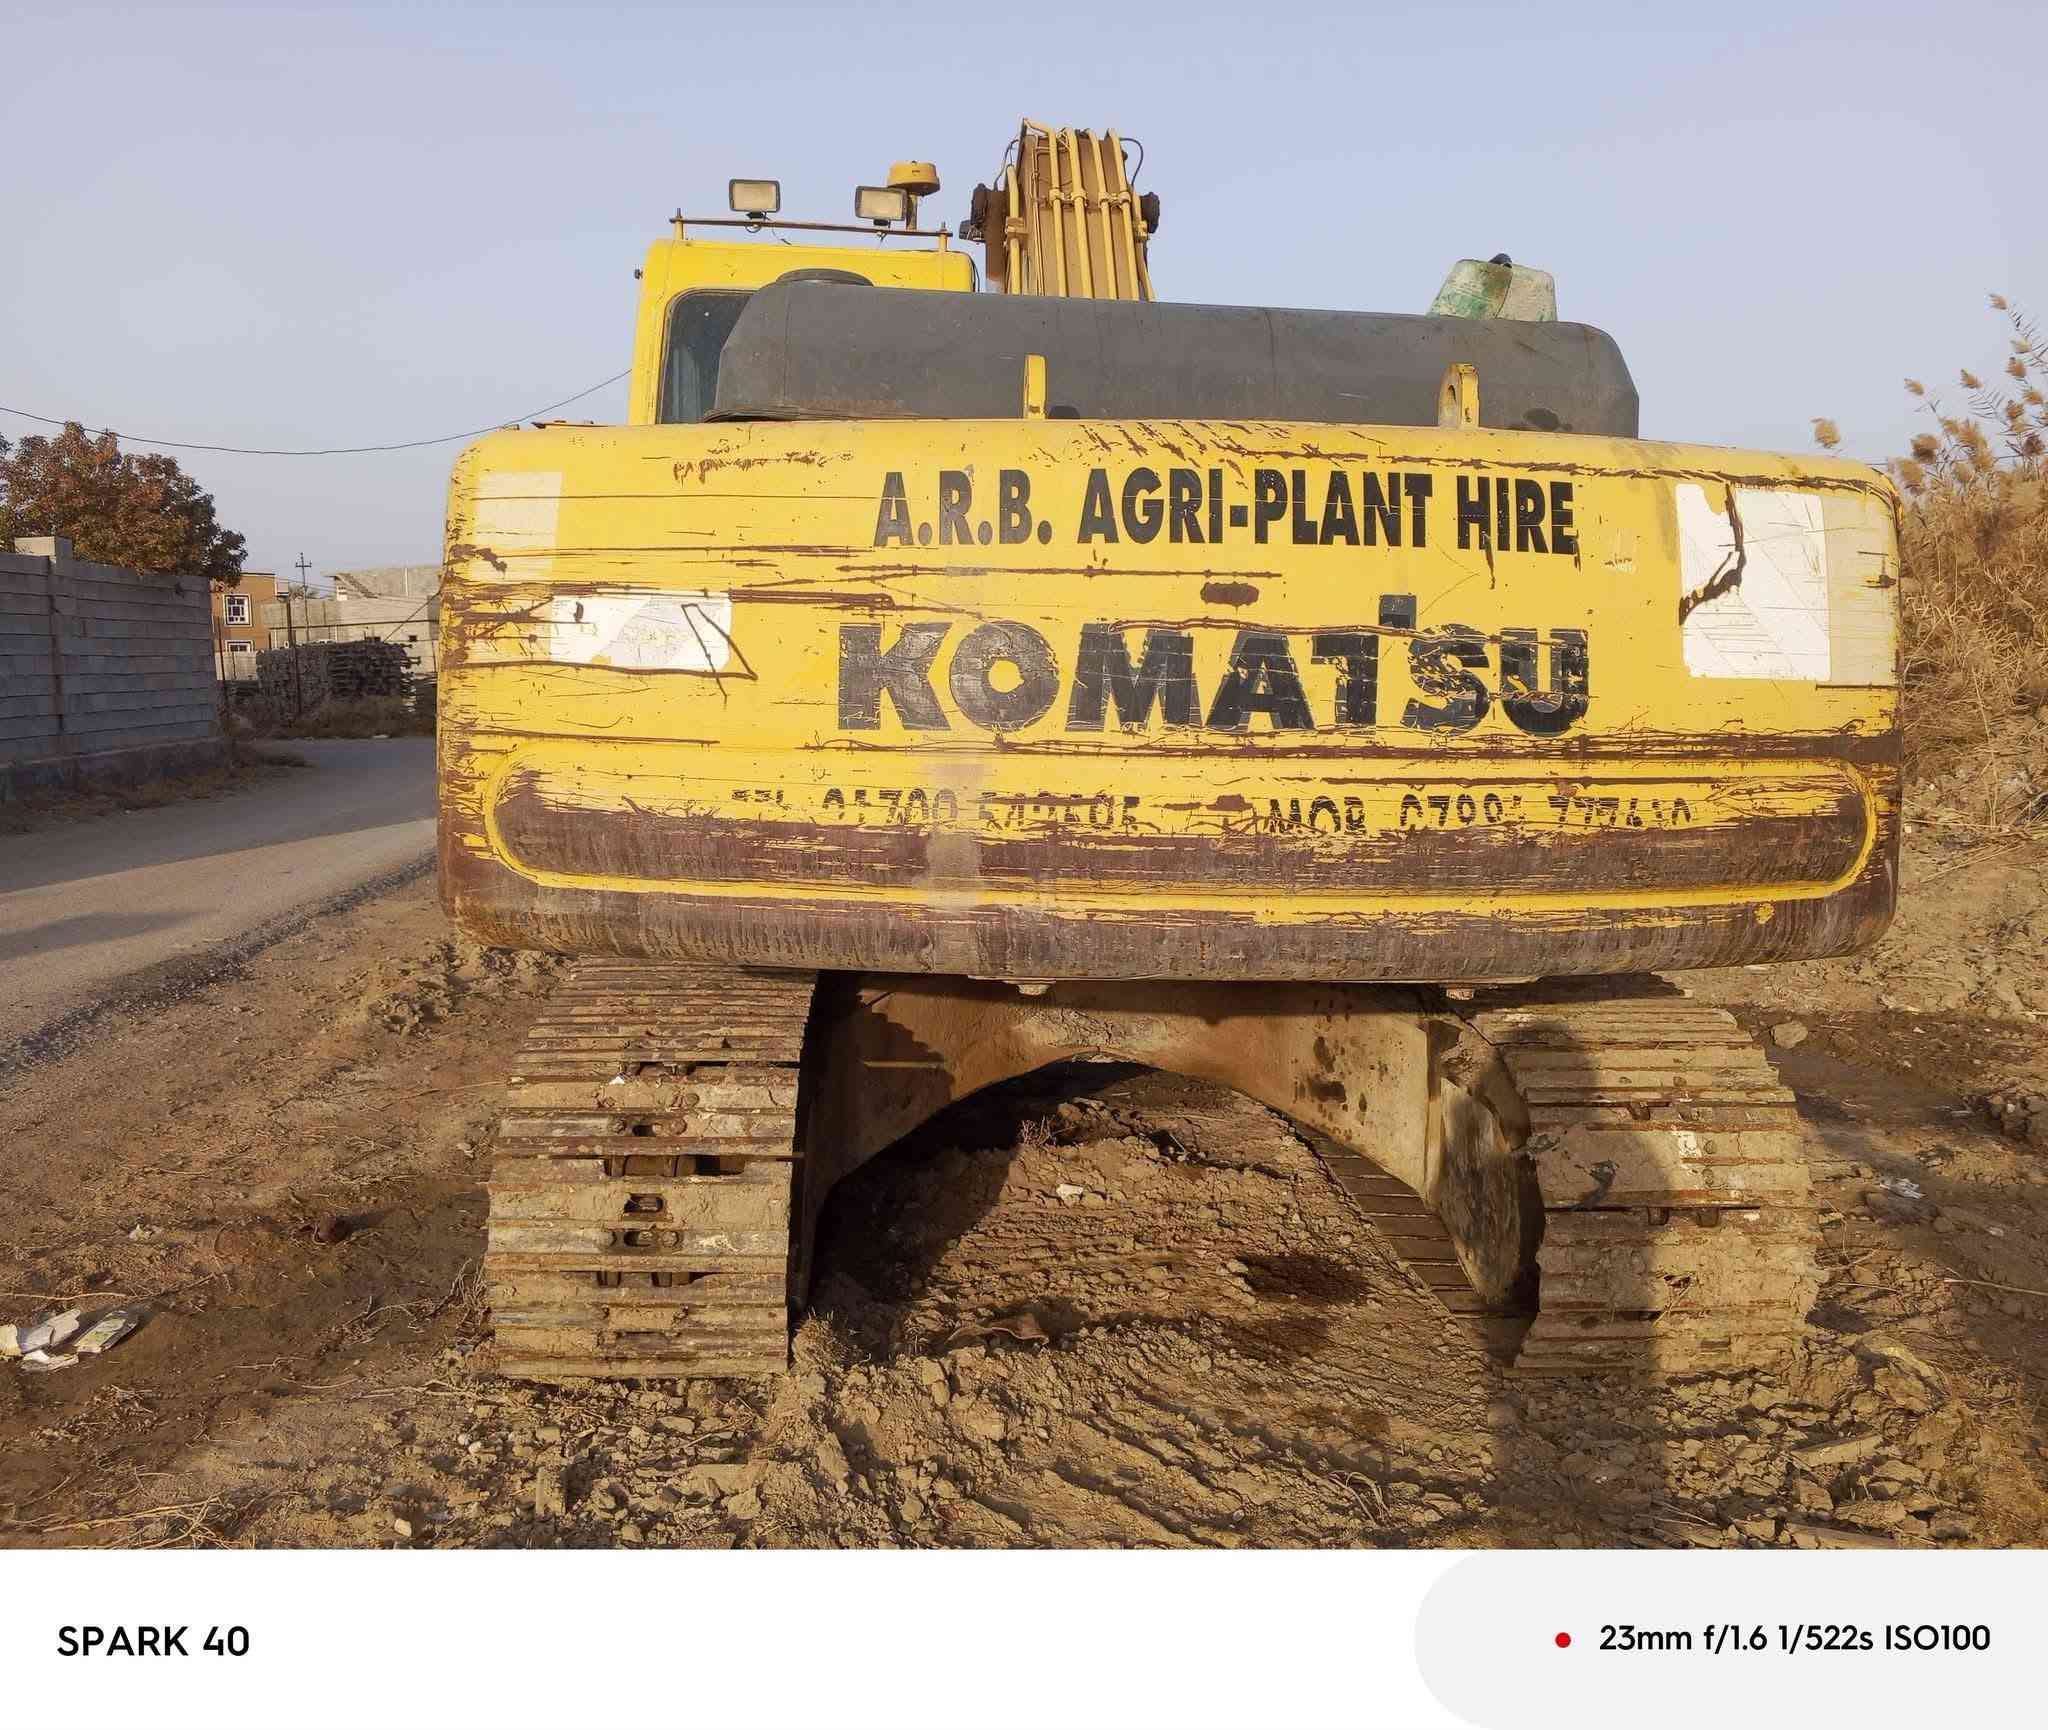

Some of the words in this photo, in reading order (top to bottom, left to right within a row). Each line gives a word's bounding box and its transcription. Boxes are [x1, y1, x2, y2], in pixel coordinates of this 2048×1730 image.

[874, 469, 1053, 546] A.R.B.
[1079, 468, 1433, 548] AGRI-PLANT
[1456, 474, 1577, 555] HIRE
[837, 594, 1591, 738] KOMATSU
